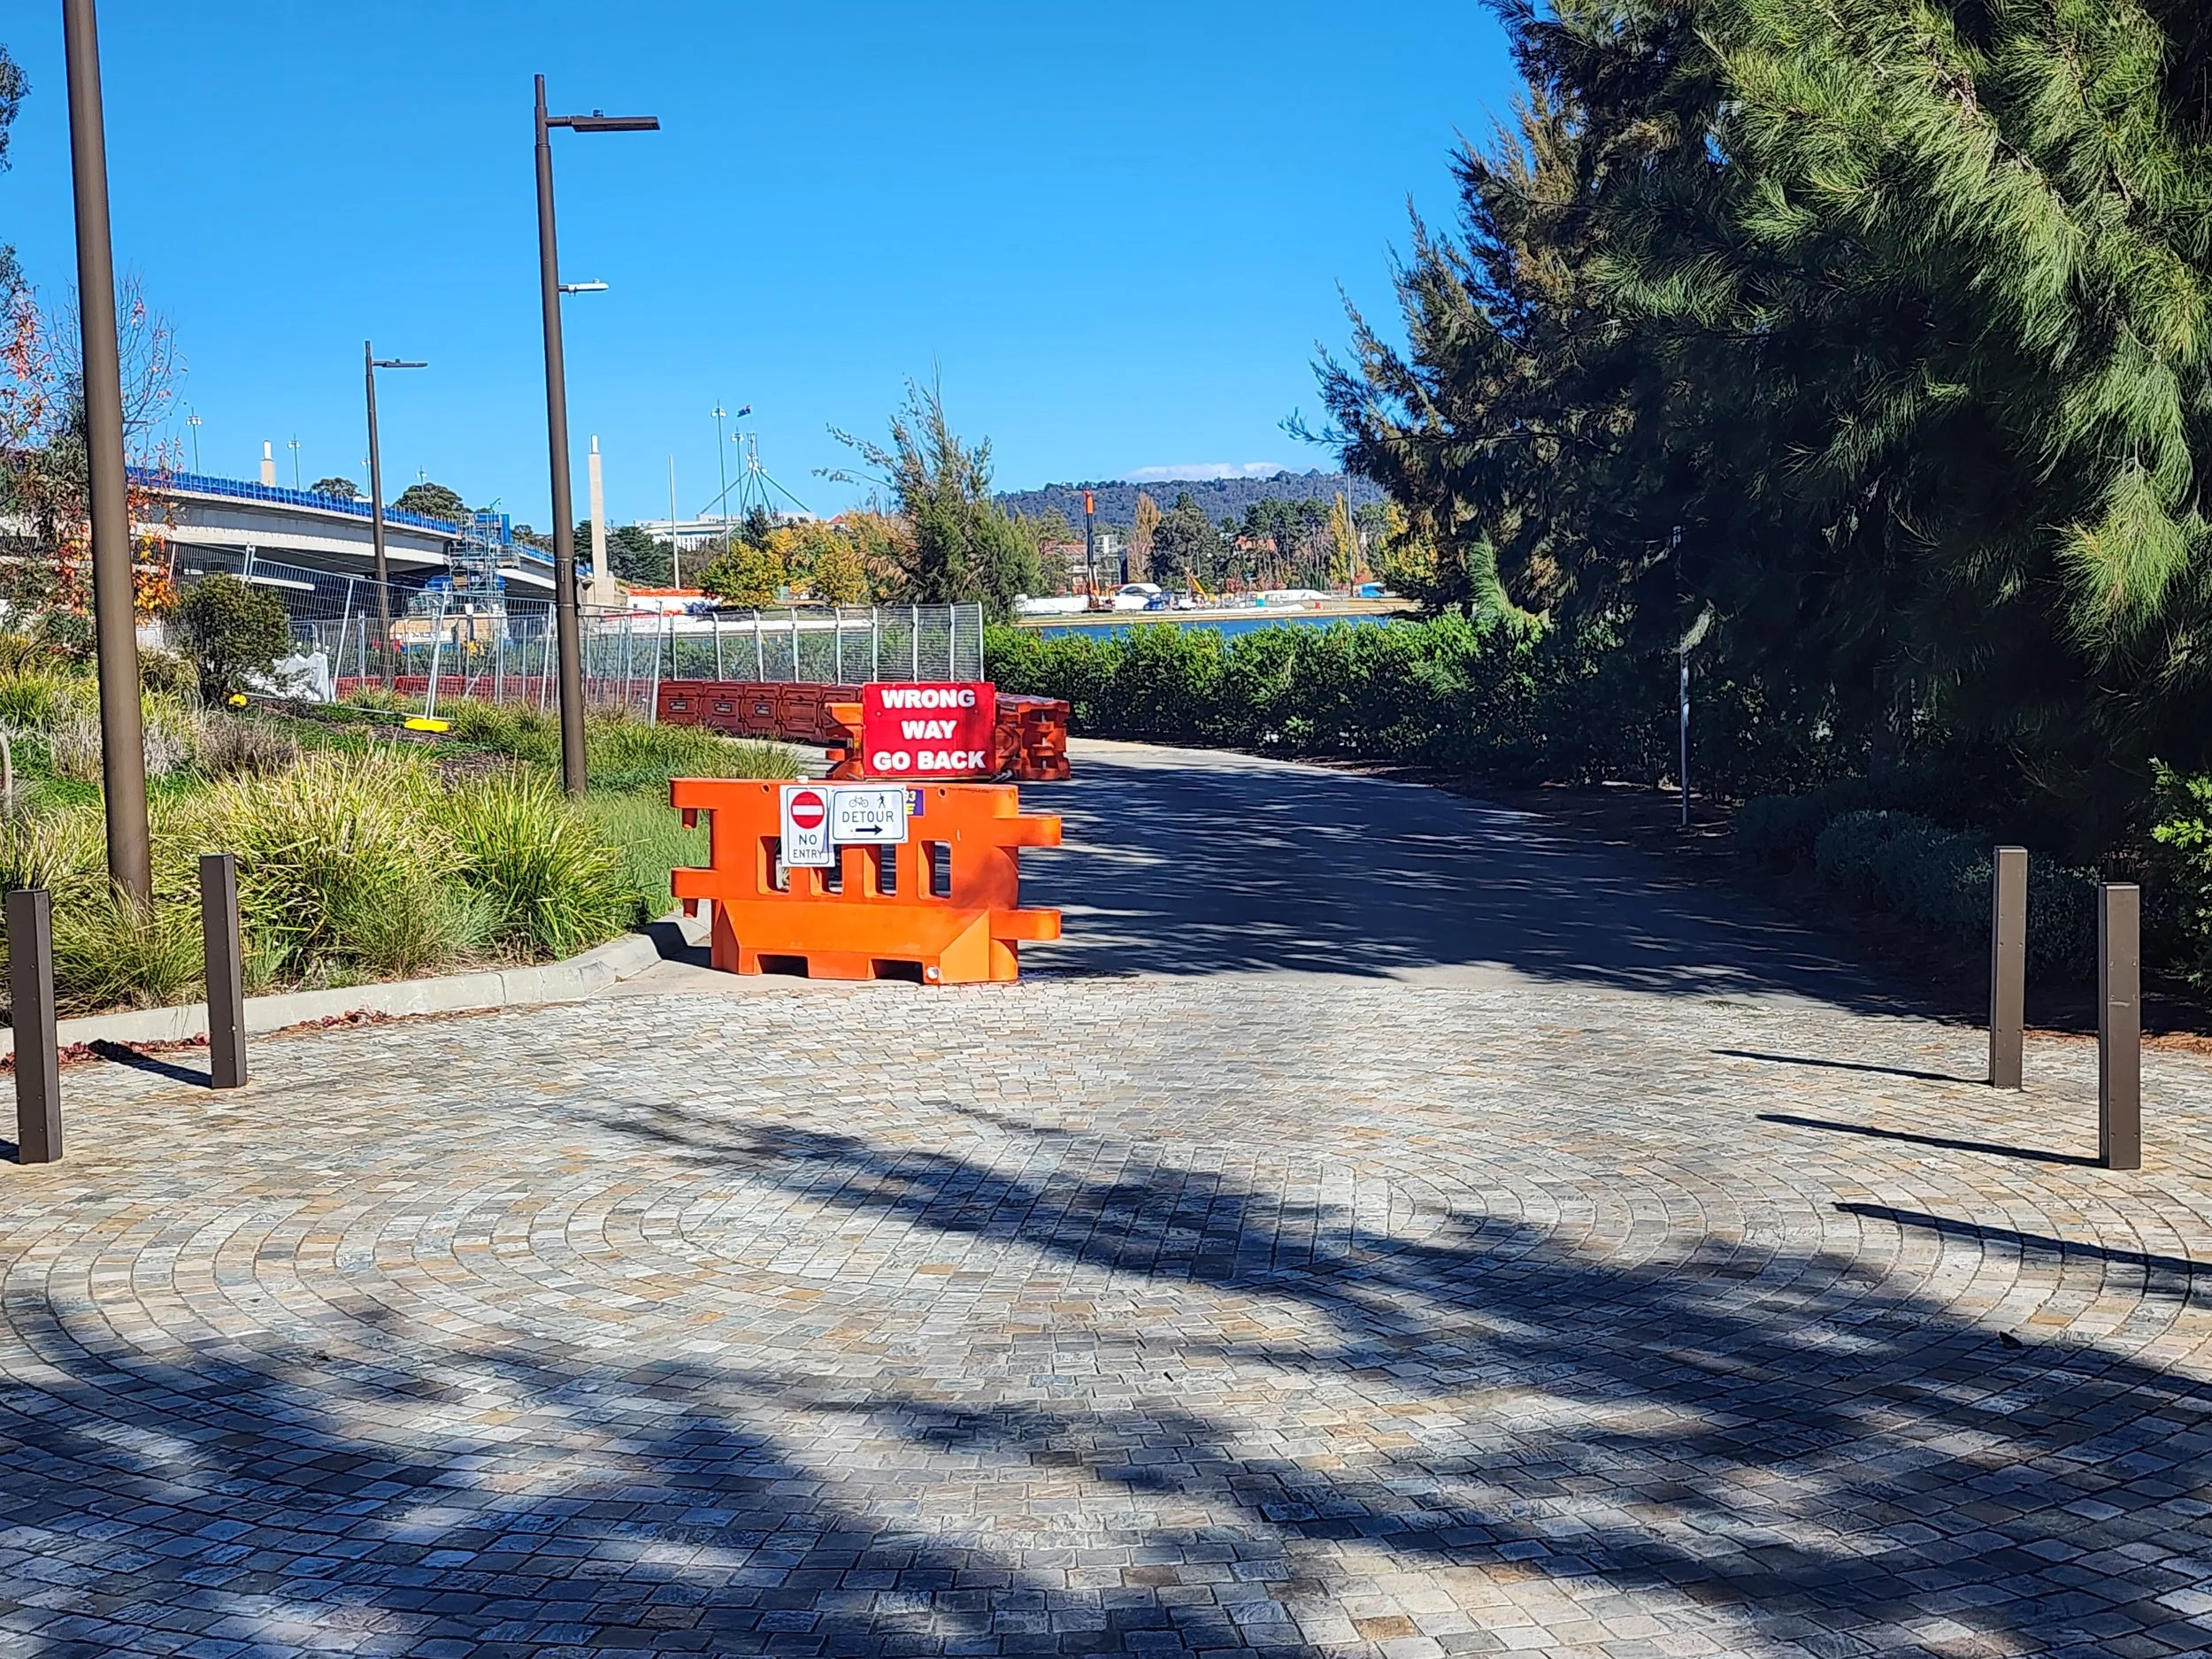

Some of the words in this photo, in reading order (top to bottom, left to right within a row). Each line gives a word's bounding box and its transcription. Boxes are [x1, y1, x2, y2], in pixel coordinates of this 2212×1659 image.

[881, 689, 975, 708] WRONG
[901, 720, 956, 740] WAY
[872, 751, 910, 771] GO
[918, 750, 986, 770] BACK
[842, 810, 894, 823] DETOUR
[799, 834, 817, 845] NO
[793, 849, 823, 858] ENTRY
